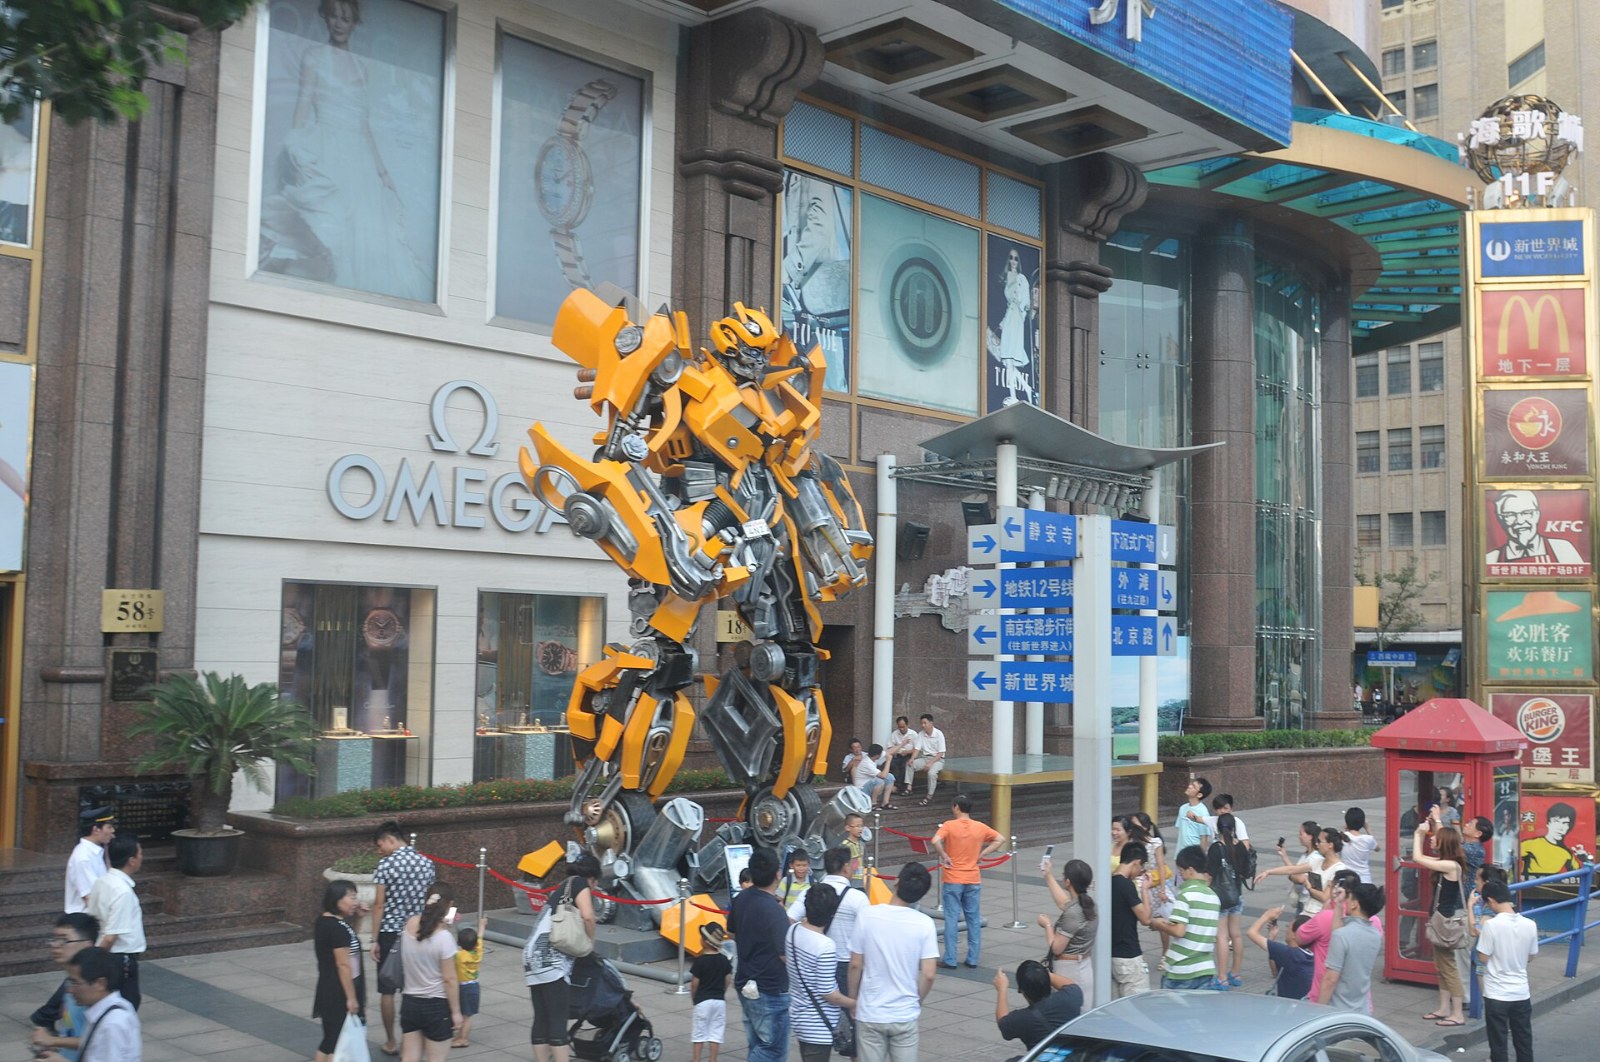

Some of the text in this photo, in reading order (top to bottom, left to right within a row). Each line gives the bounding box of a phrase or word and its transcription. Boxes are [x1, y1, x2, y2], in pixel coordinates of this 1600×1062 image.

[1498, 172, 1554, 196] 11F
[1513, 237, 1579, 253] 新世界城
[1498, 357, 1571, 373] 地下一层
[1501, 451, 1550, 465] 永和大王
[326, 454, 580, 535] OMEGA
[1028, 521, 1073, 546] 静安寺
[1544, 520, 1584, 533] KFC
[1111, 531, 1155, 553] 下沉式广场
[1491, 566, 1584, 575] 新世界城购物广场B1F
[1118, 572, 1149, 591] 外滩
[1112, 627, 1153, 646] 北京路
[1507, 623, 1571, 643] 必胜客
[1506, 647, 1573, 662] 欢乐餐厅
[1004, 673, 1074, 692] 新世界城
[1523, 707, 1557, 722] BURGER
[1525, 714, 1559, 732] KING
[1520, 810, 1536, 823] 夫
